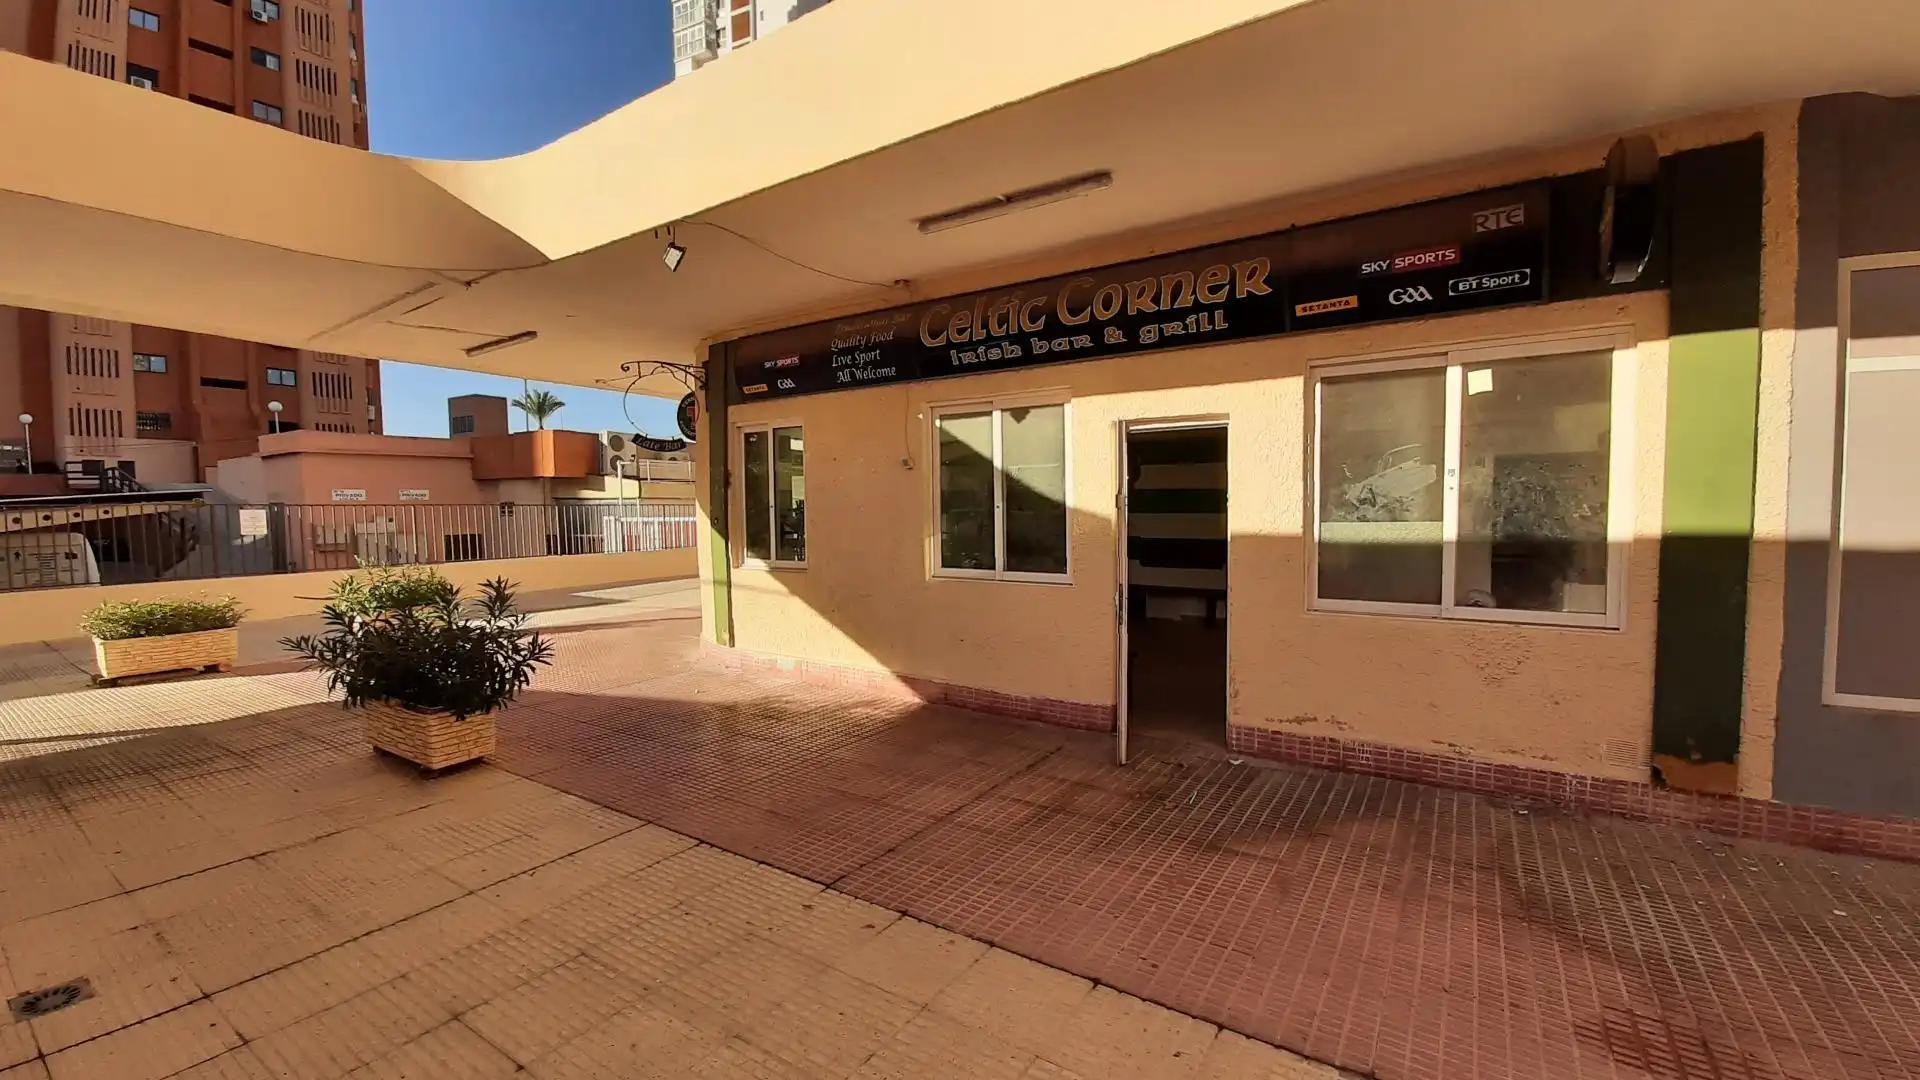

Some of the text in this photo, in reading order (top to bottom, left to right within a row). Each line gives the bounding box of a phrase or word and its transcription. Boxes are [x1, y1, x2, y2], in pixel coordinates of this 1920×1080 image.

[1360, 248, 1457, 275] SKY SPORTS
[1458, 273, 1521, 291] BT Sport
[919, 256, 1274, 348] Celtic Corner
[1300, 298, 1351, 314] SETANTA
[831, 333, 867, 352] Quality
[950, 309, 1229, 366] Irish bar & grill
[776, 356, 799, 367] SPORTS
[832, 349, 881, 367] Live Sport
[836, 366, 897, 384] All Welcome
